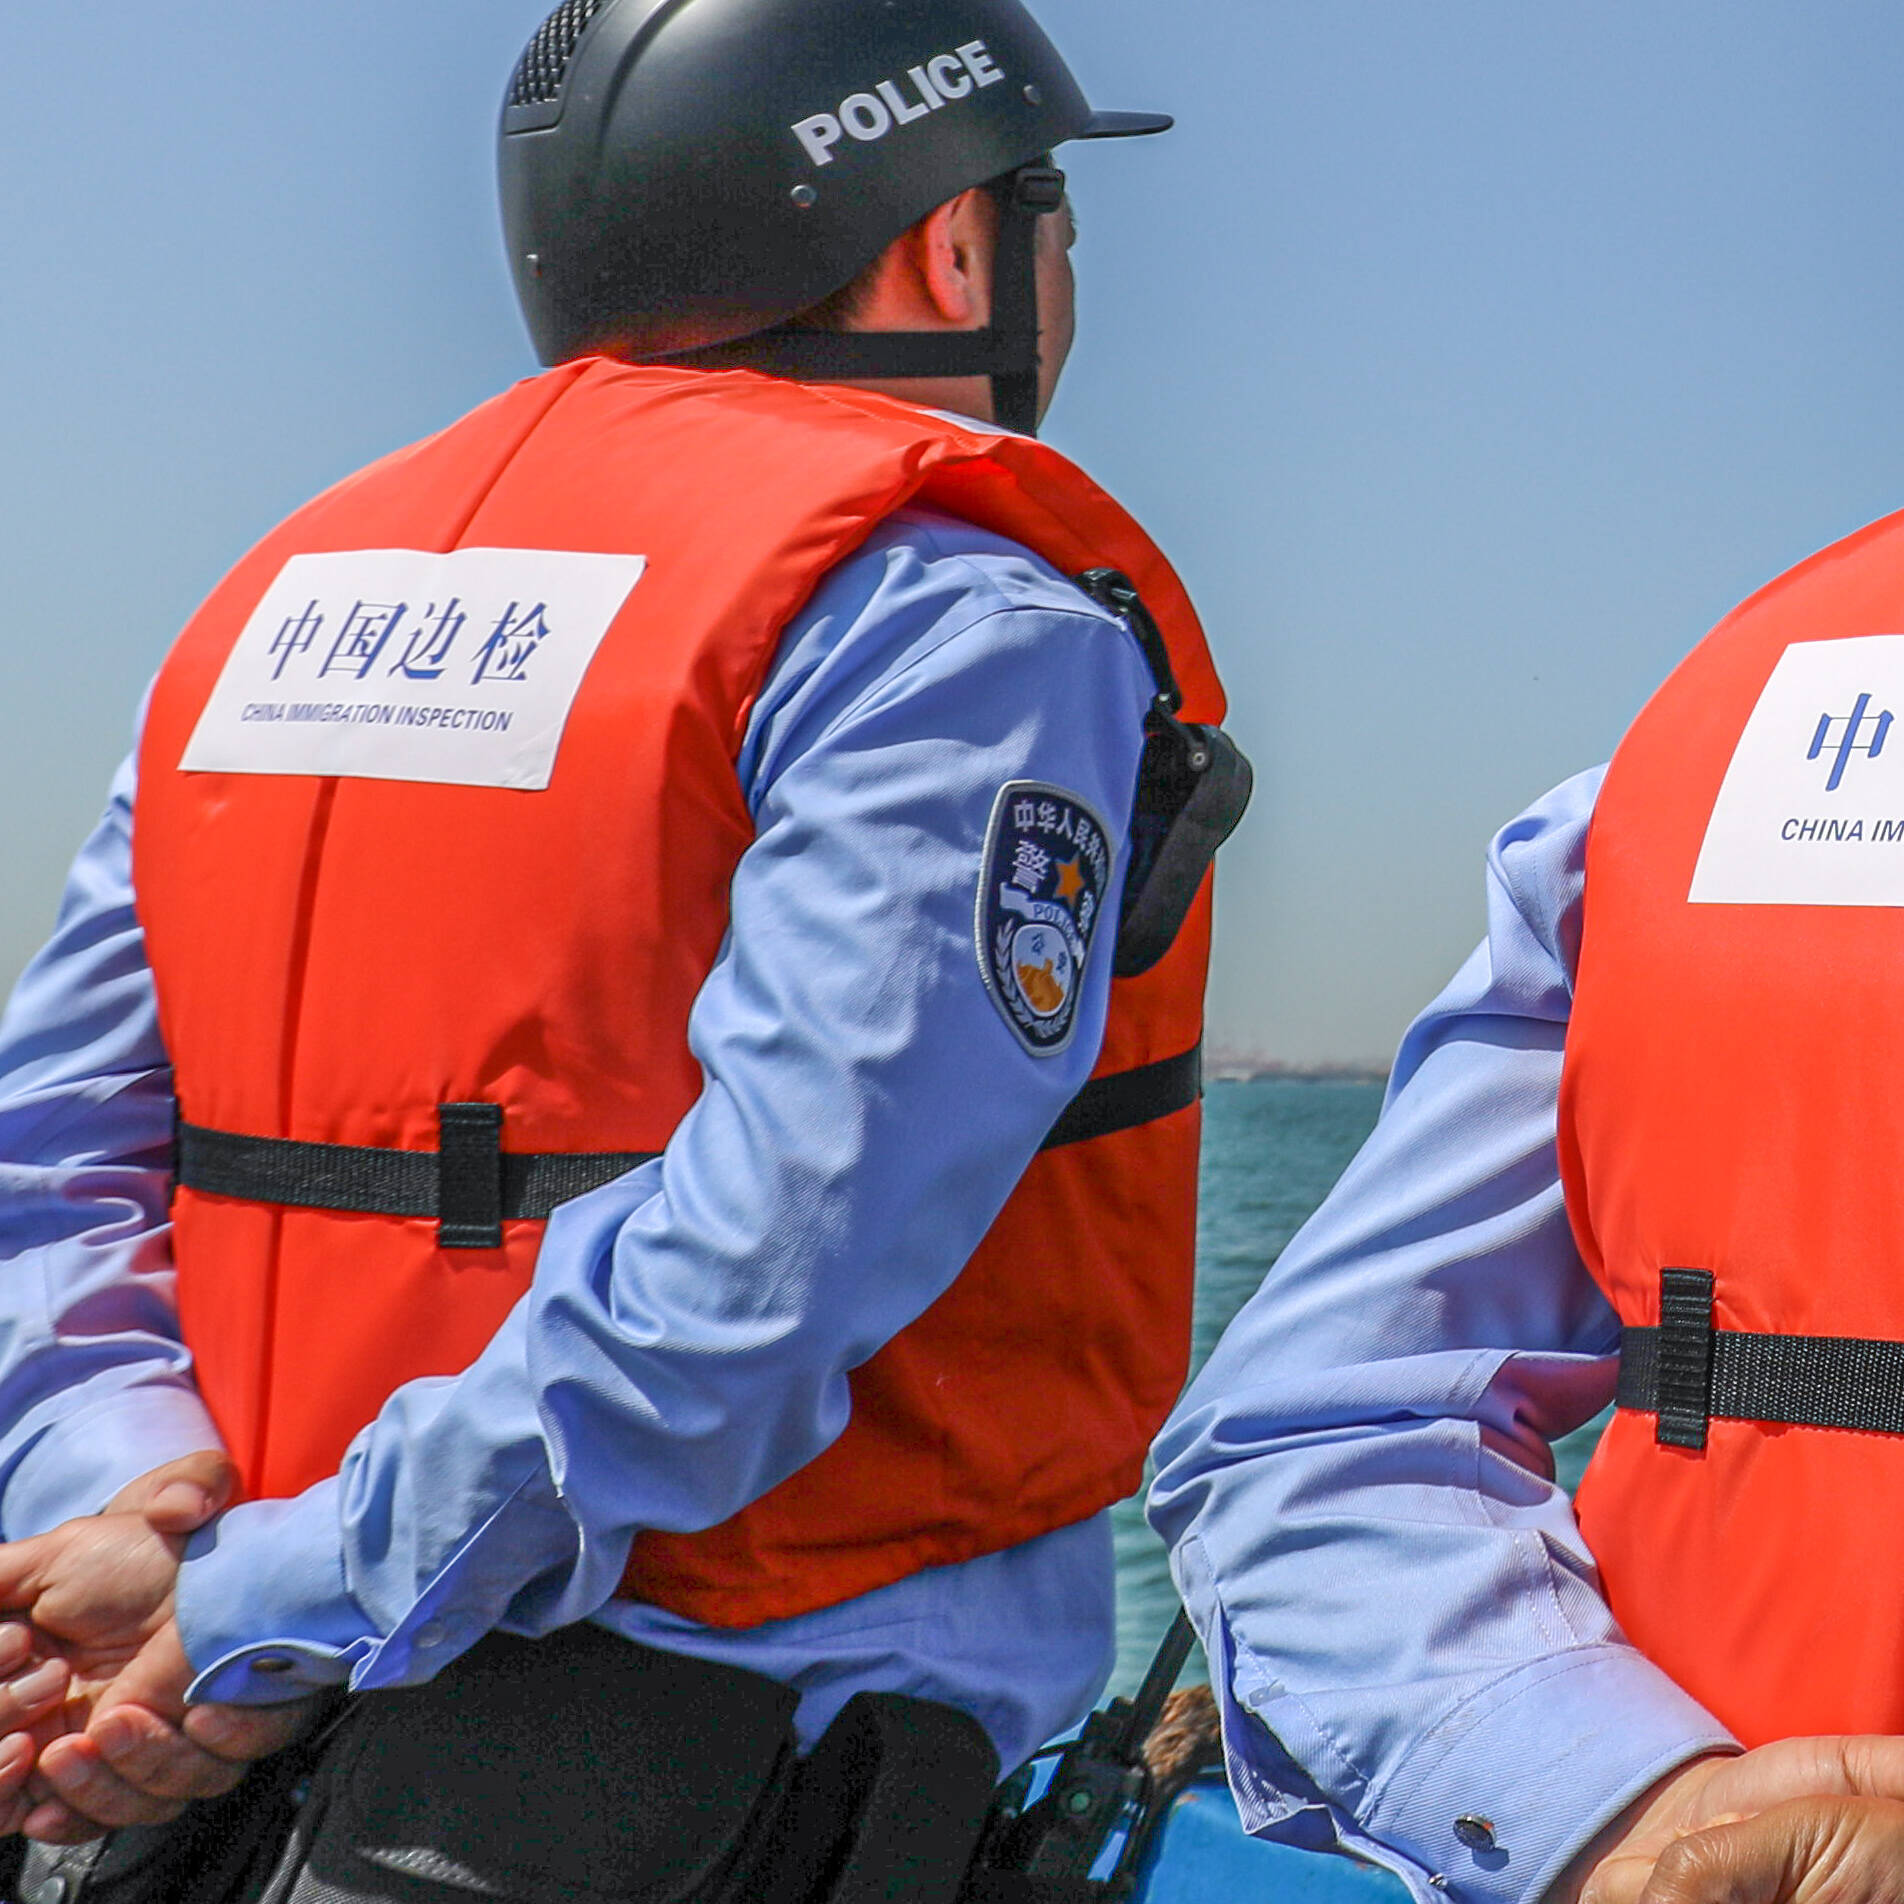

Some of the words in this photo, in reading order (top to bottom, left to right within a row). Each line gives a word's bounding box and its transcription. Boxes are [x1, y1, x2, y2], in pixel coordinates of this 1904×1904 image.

[791, 40, 1005, 166] POLICE
[268, 597, 552, 685] 中国边检
[240, 702, 286, 722] CHINA
[286, 702, 396, 725] IMMIGRATION
[395, 706, 515, 731] INSPECTION
[1780, 818, 1863, 842] CHINA
